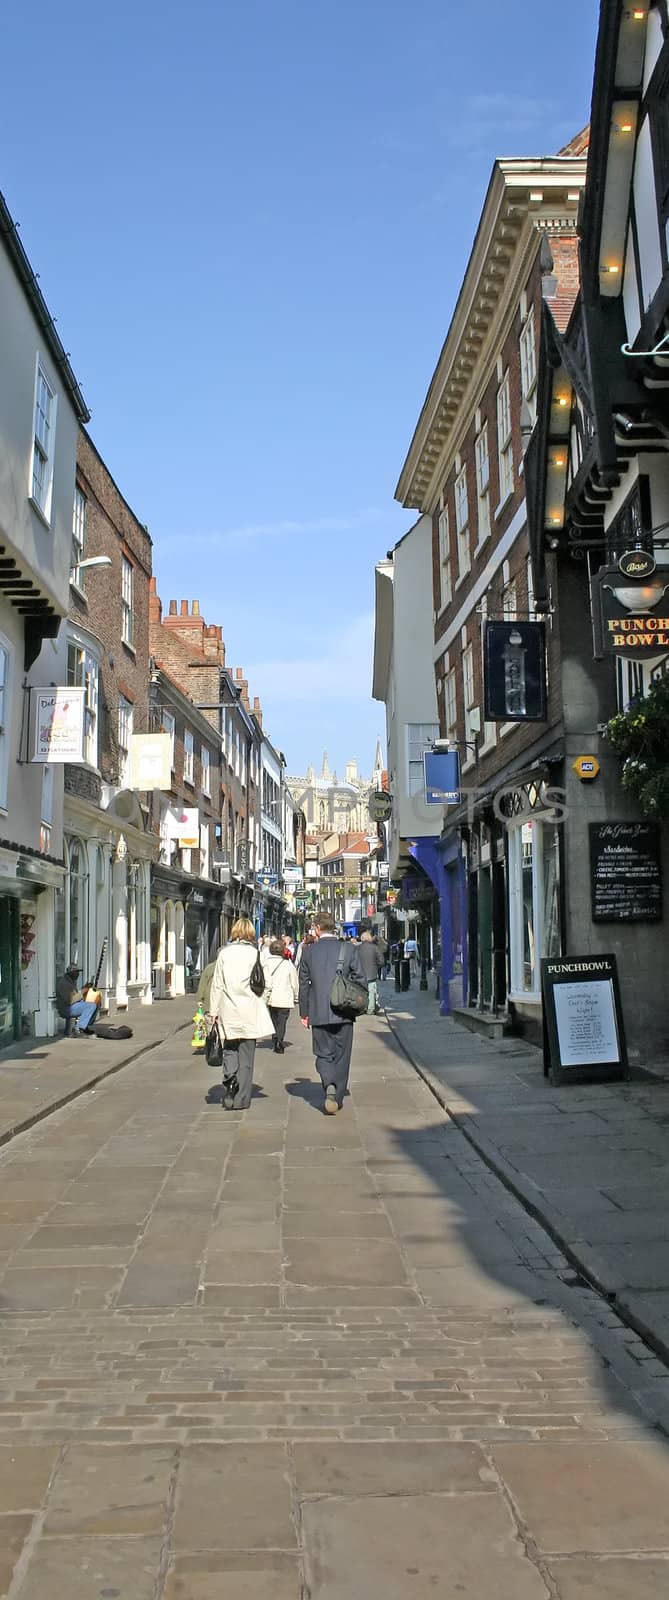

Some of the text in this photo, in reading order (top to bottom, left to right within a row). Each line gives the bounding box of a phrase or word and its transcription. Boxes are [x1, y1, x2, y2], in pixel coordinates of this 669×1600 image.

[627, 562, 648, 572] Bass
[608, 619, 669, 631] PUNCH
[613, 634, 669, 646] BOWL
[548, 962, 611, 974] PUNCHBOWL
